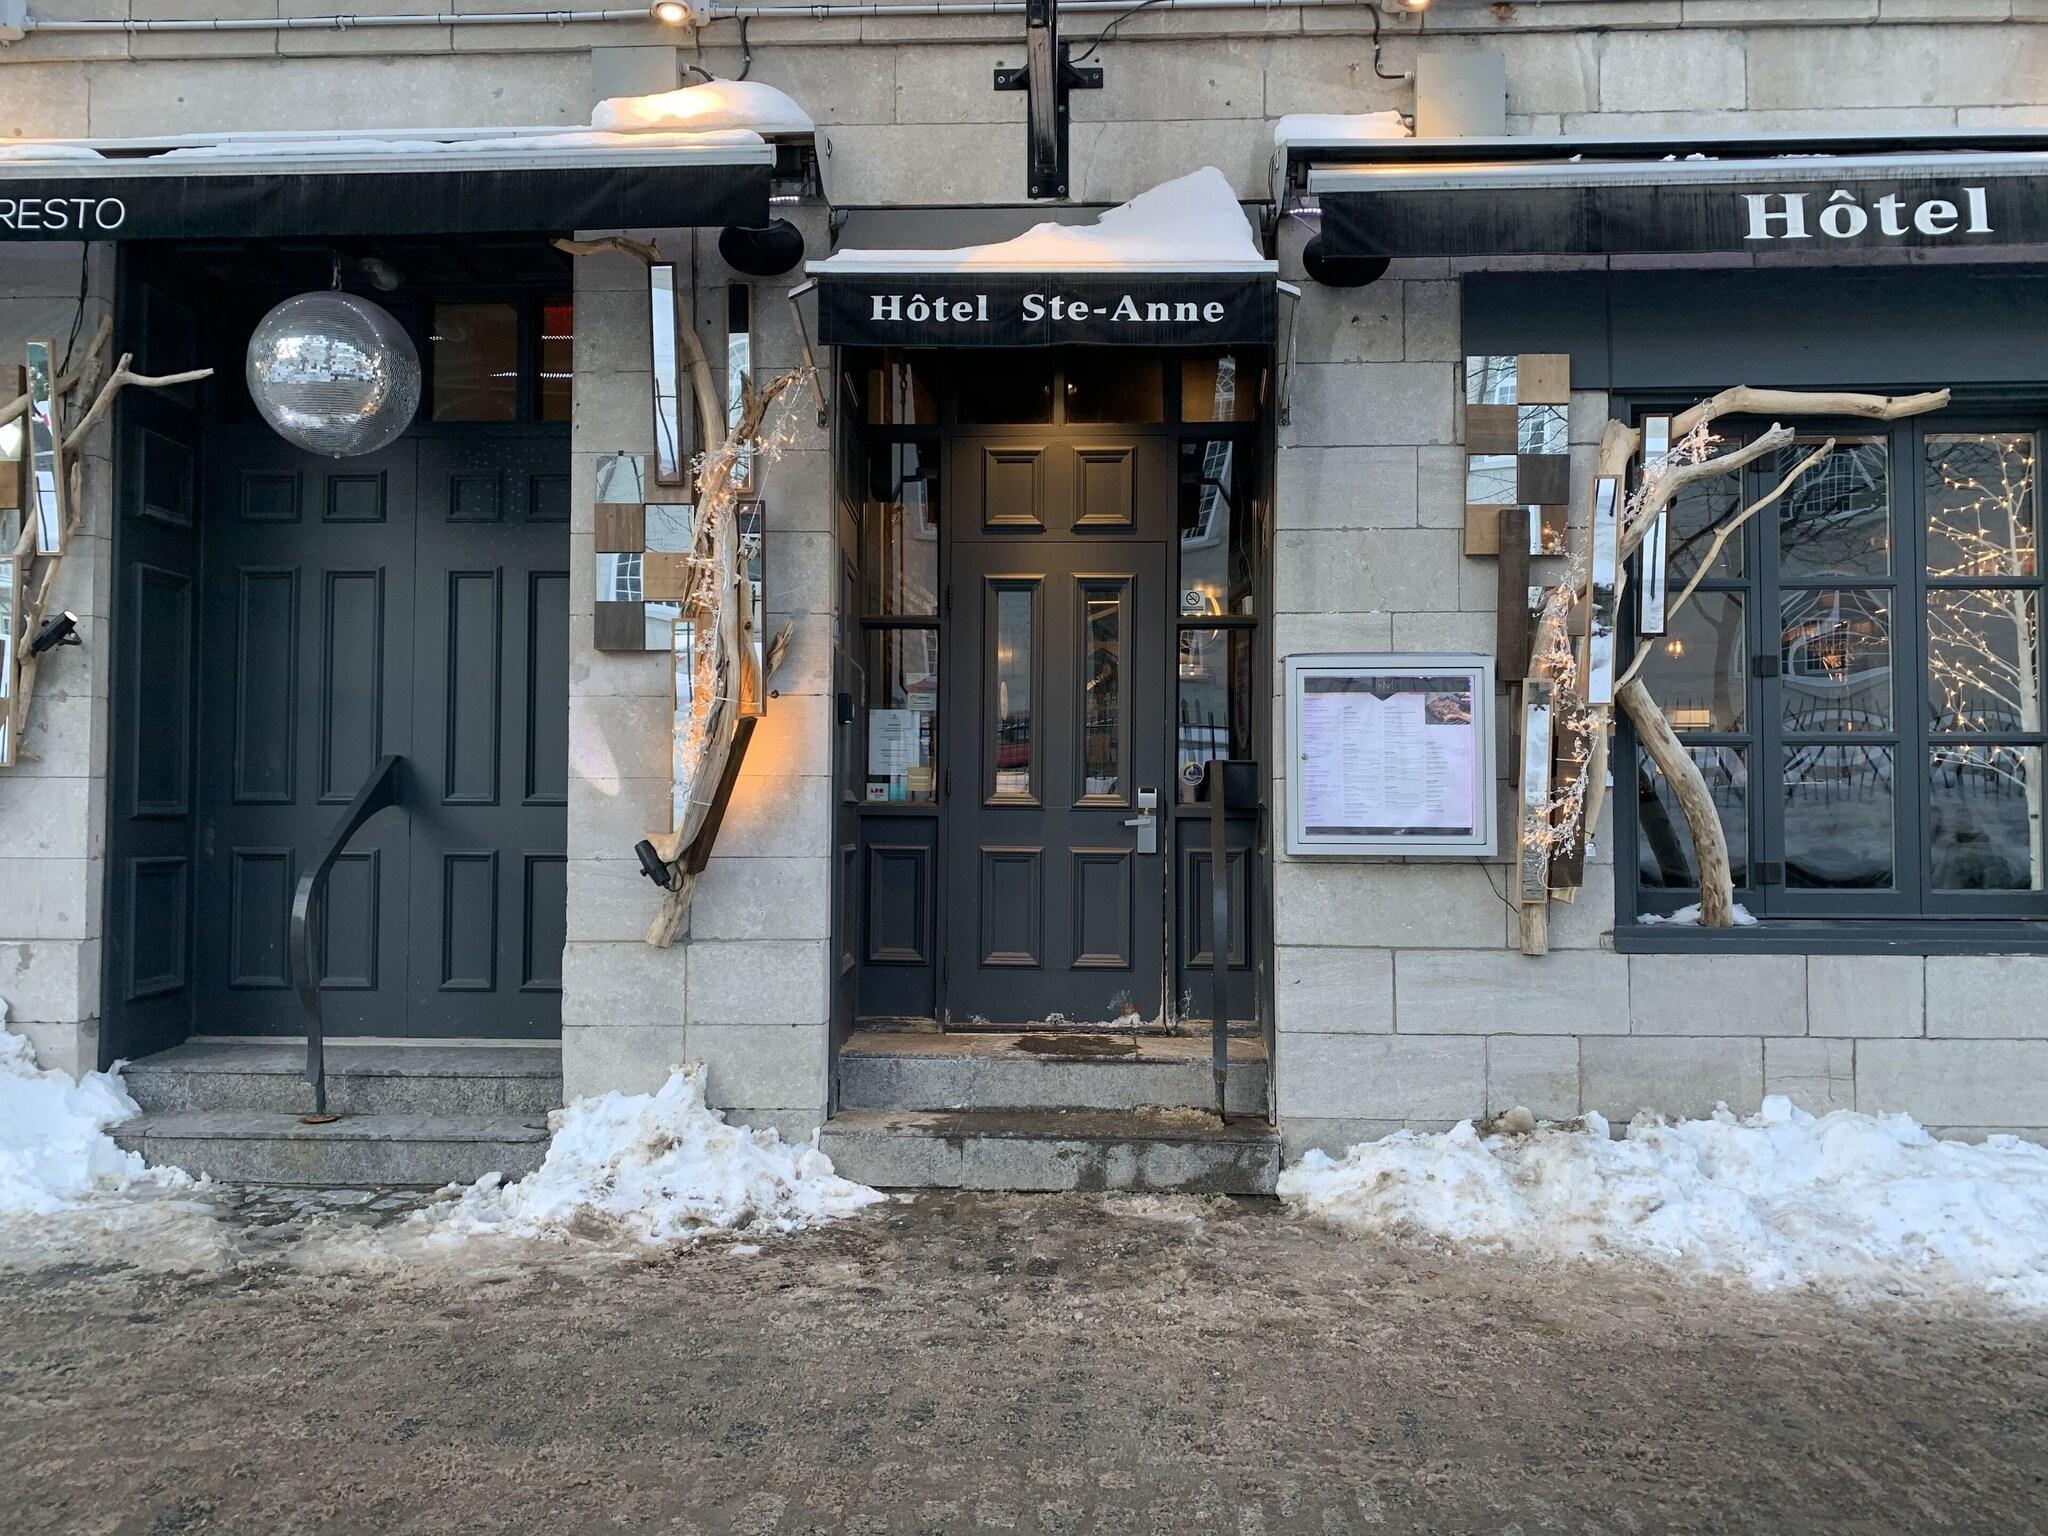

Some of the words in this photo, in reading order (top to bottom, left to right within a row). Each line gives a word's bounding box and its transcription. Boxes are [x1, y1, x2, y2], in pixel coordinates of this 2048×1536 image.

[0, 198, 125, 229] RESTO
[1740, 187, 1995, 239] Hôtel
[870, 293, 989, 322] Hôtel
[1022, 293, 1225, 323] Ste-Anne
